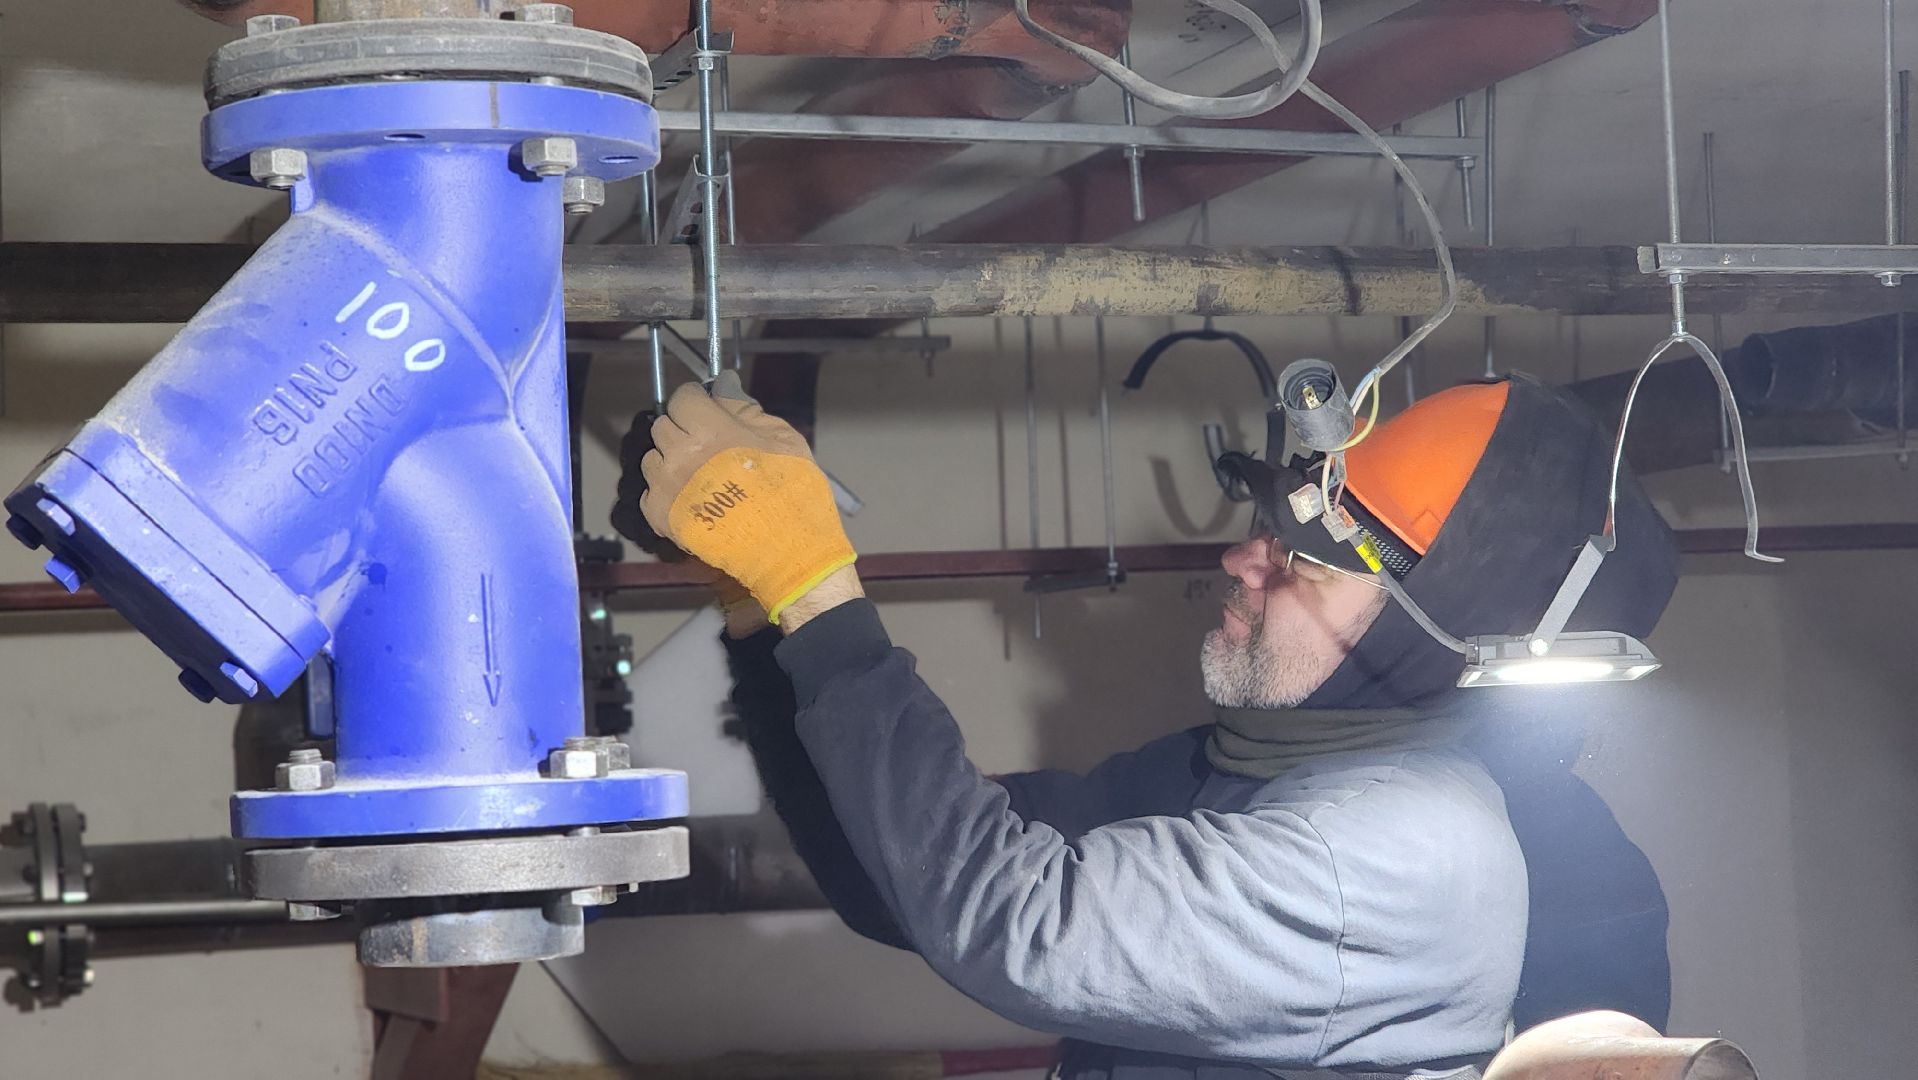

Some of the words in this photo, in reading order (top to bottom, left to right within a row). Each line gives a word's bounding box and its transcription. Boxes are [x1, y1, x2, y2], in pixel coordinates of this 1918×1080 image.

[335, 281, 446, 372] 100
[251, 339, 357, 446] PN16
[292, 373, 405, 498] DN100
